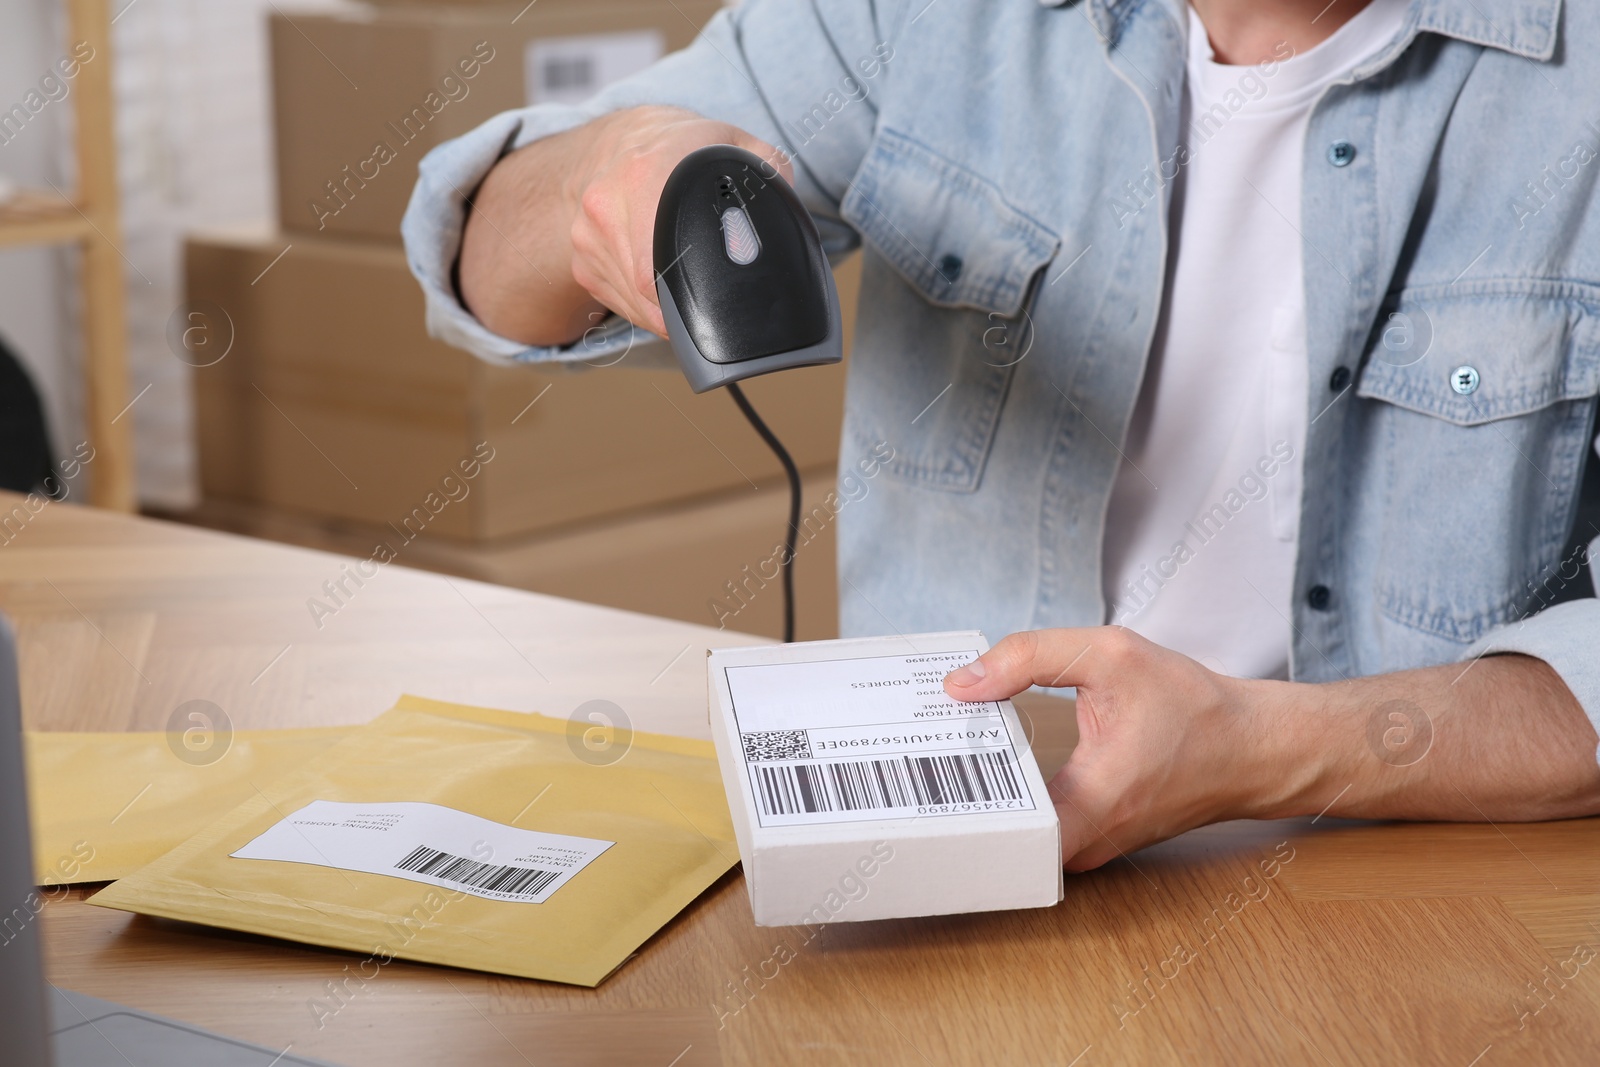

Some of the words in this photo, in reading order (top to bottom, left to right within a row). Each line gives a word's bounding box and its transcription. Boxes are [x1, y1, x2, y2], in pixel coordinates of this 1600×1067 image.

[905, 654, 970, 664] 1234567890
[850, 678, 910, 688] ADDRESS
[913, 710, 951, 718] FROM
[956, 708, 989, 716] SENT
[918, 800, 1026, 815] 1234567890
[341, 823, 390, 832] SHIPPING
[466, 886, 534, 900] 1234567890
